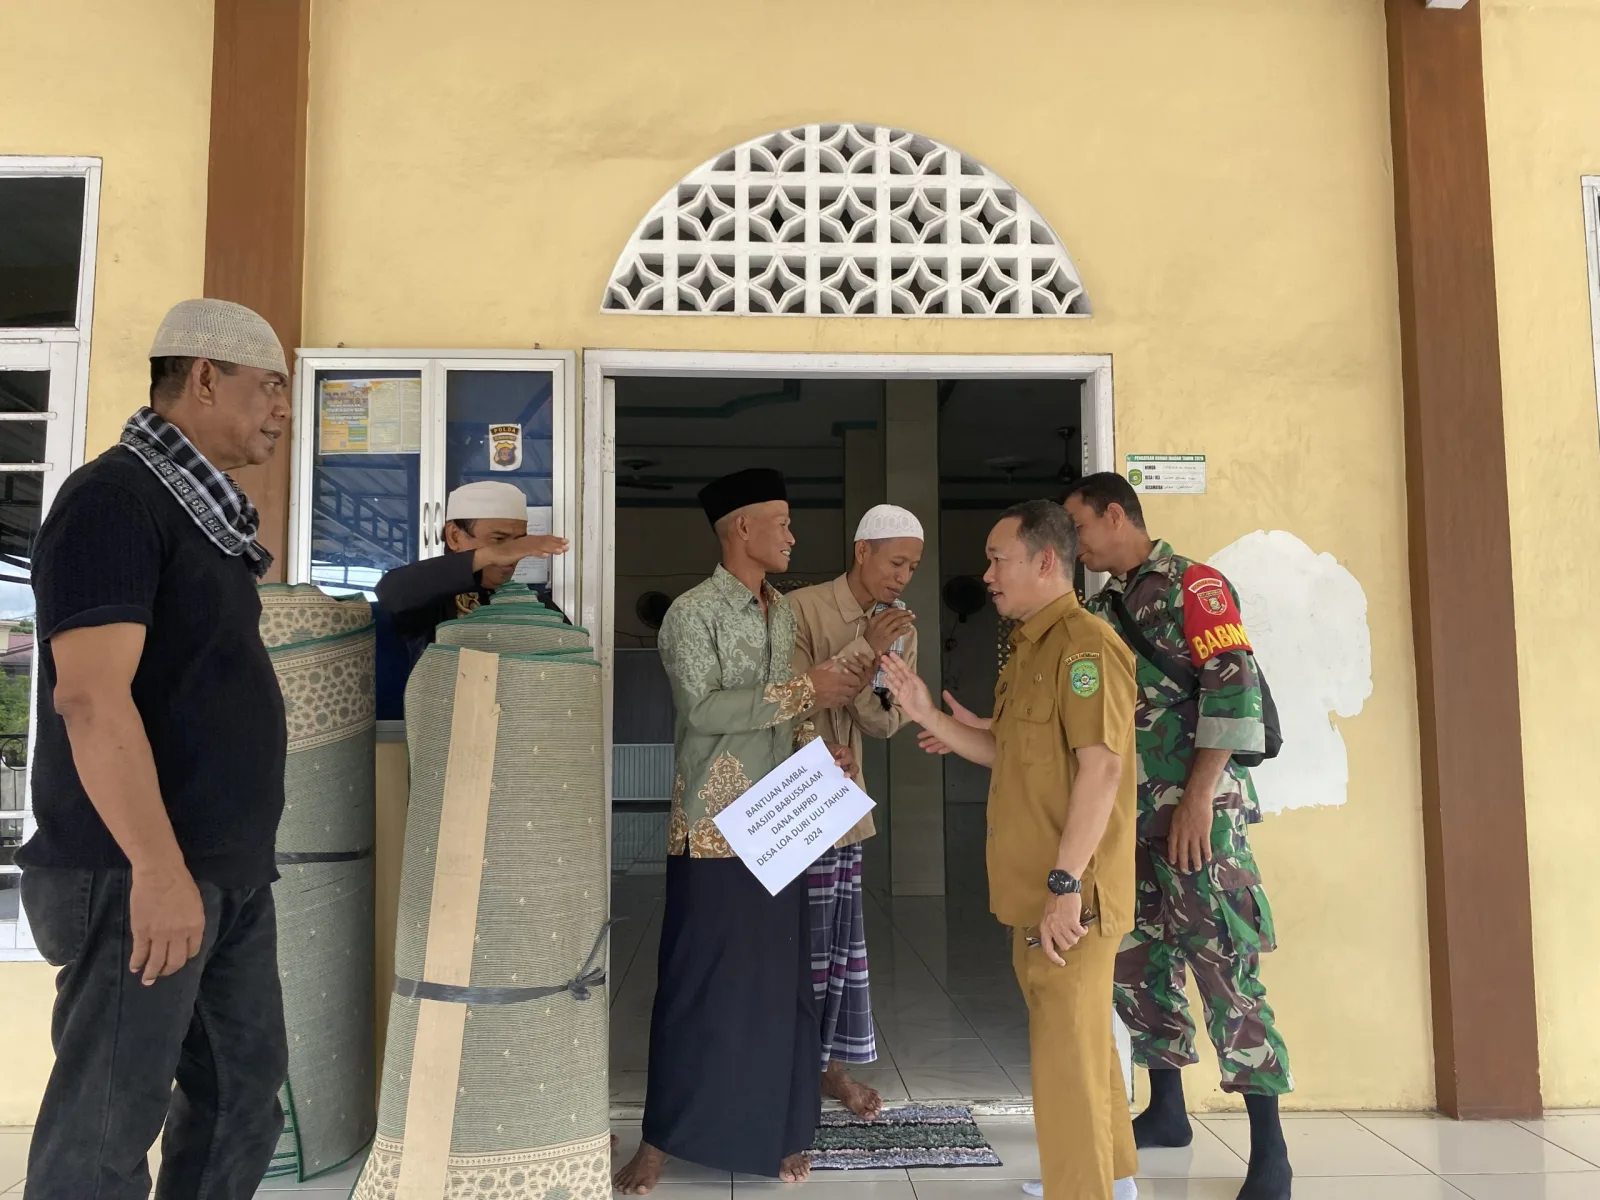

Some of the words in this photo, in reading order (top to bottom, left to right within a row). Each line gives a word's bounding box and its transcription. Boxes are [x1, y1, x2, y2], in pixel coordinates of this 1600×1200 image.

[745, 786, 781, 818] BANTUAN
[782, 765, 808, 790] AMBAL
[747, 809, 776, 836] MASJID
[776, 770, 824, 813] BABUSSALAM
[771, 815, 794, 835] DANA
[794, 793, 818, 817] BHPRD
[756, 847, 777, 866] DESA
[776, 835, 793, 851] LOA
[793, 818, 810, 837] DURI
[810, 806, 825, 822] ULU
[825, 785, 850, 811] TAHUN
[803, 827, 823, 846] 2024
